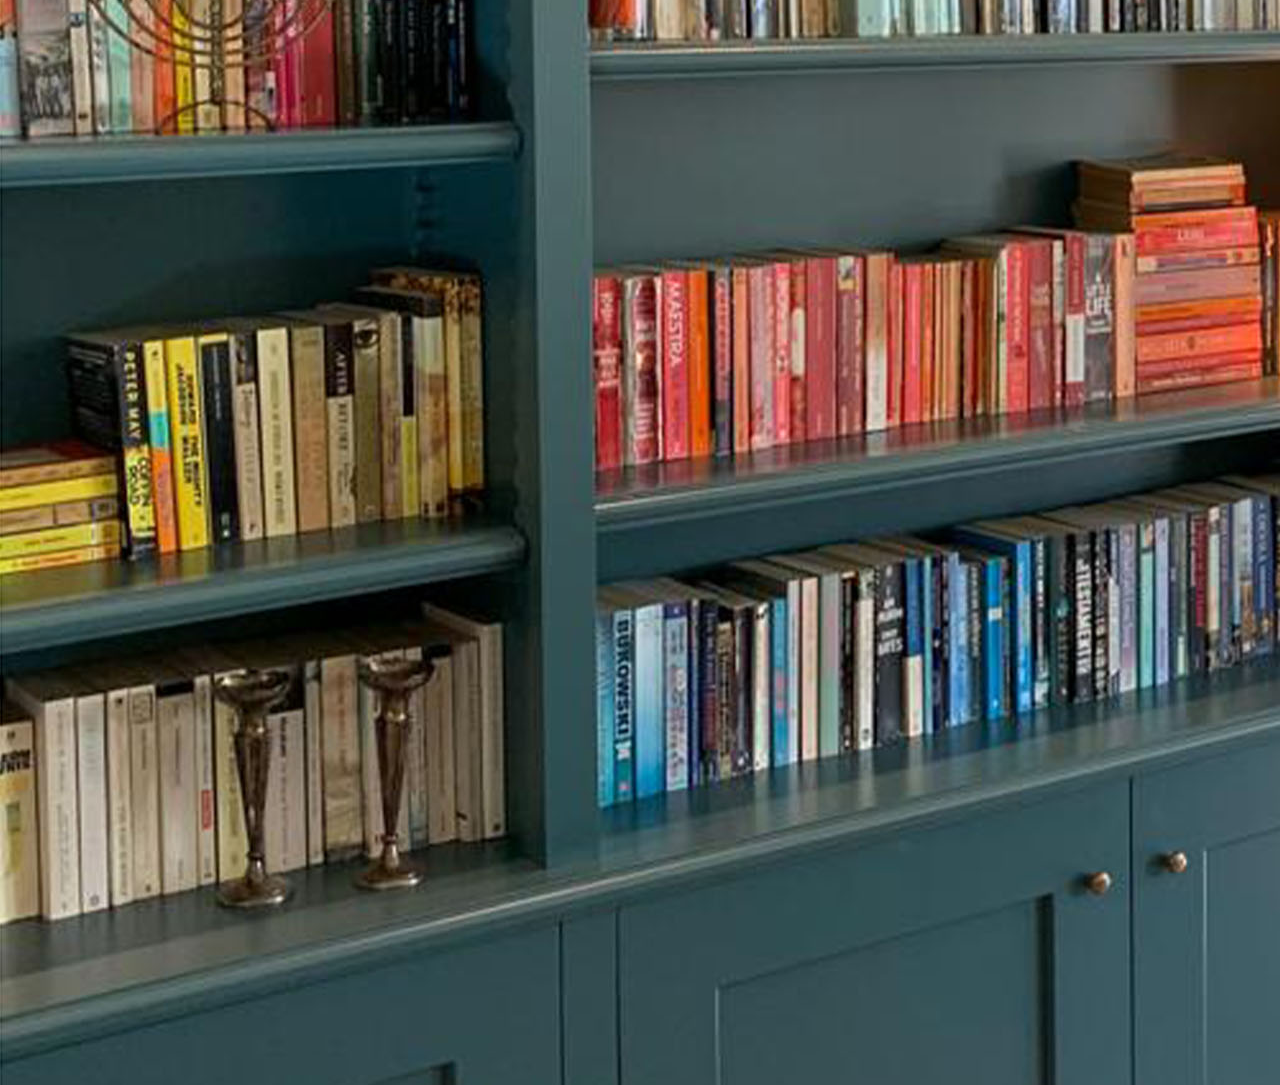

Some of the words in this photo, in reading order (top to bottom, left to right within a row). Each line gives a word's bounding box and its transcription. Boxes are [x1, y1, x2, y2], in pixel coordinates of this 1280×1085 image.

[668, 281, 684, 367] MAESTRA
[123, 351, 138, 402] PETER
[126, 409, 141, 440] MAY
[614, 618, 632, 736] BUKOWSKI
